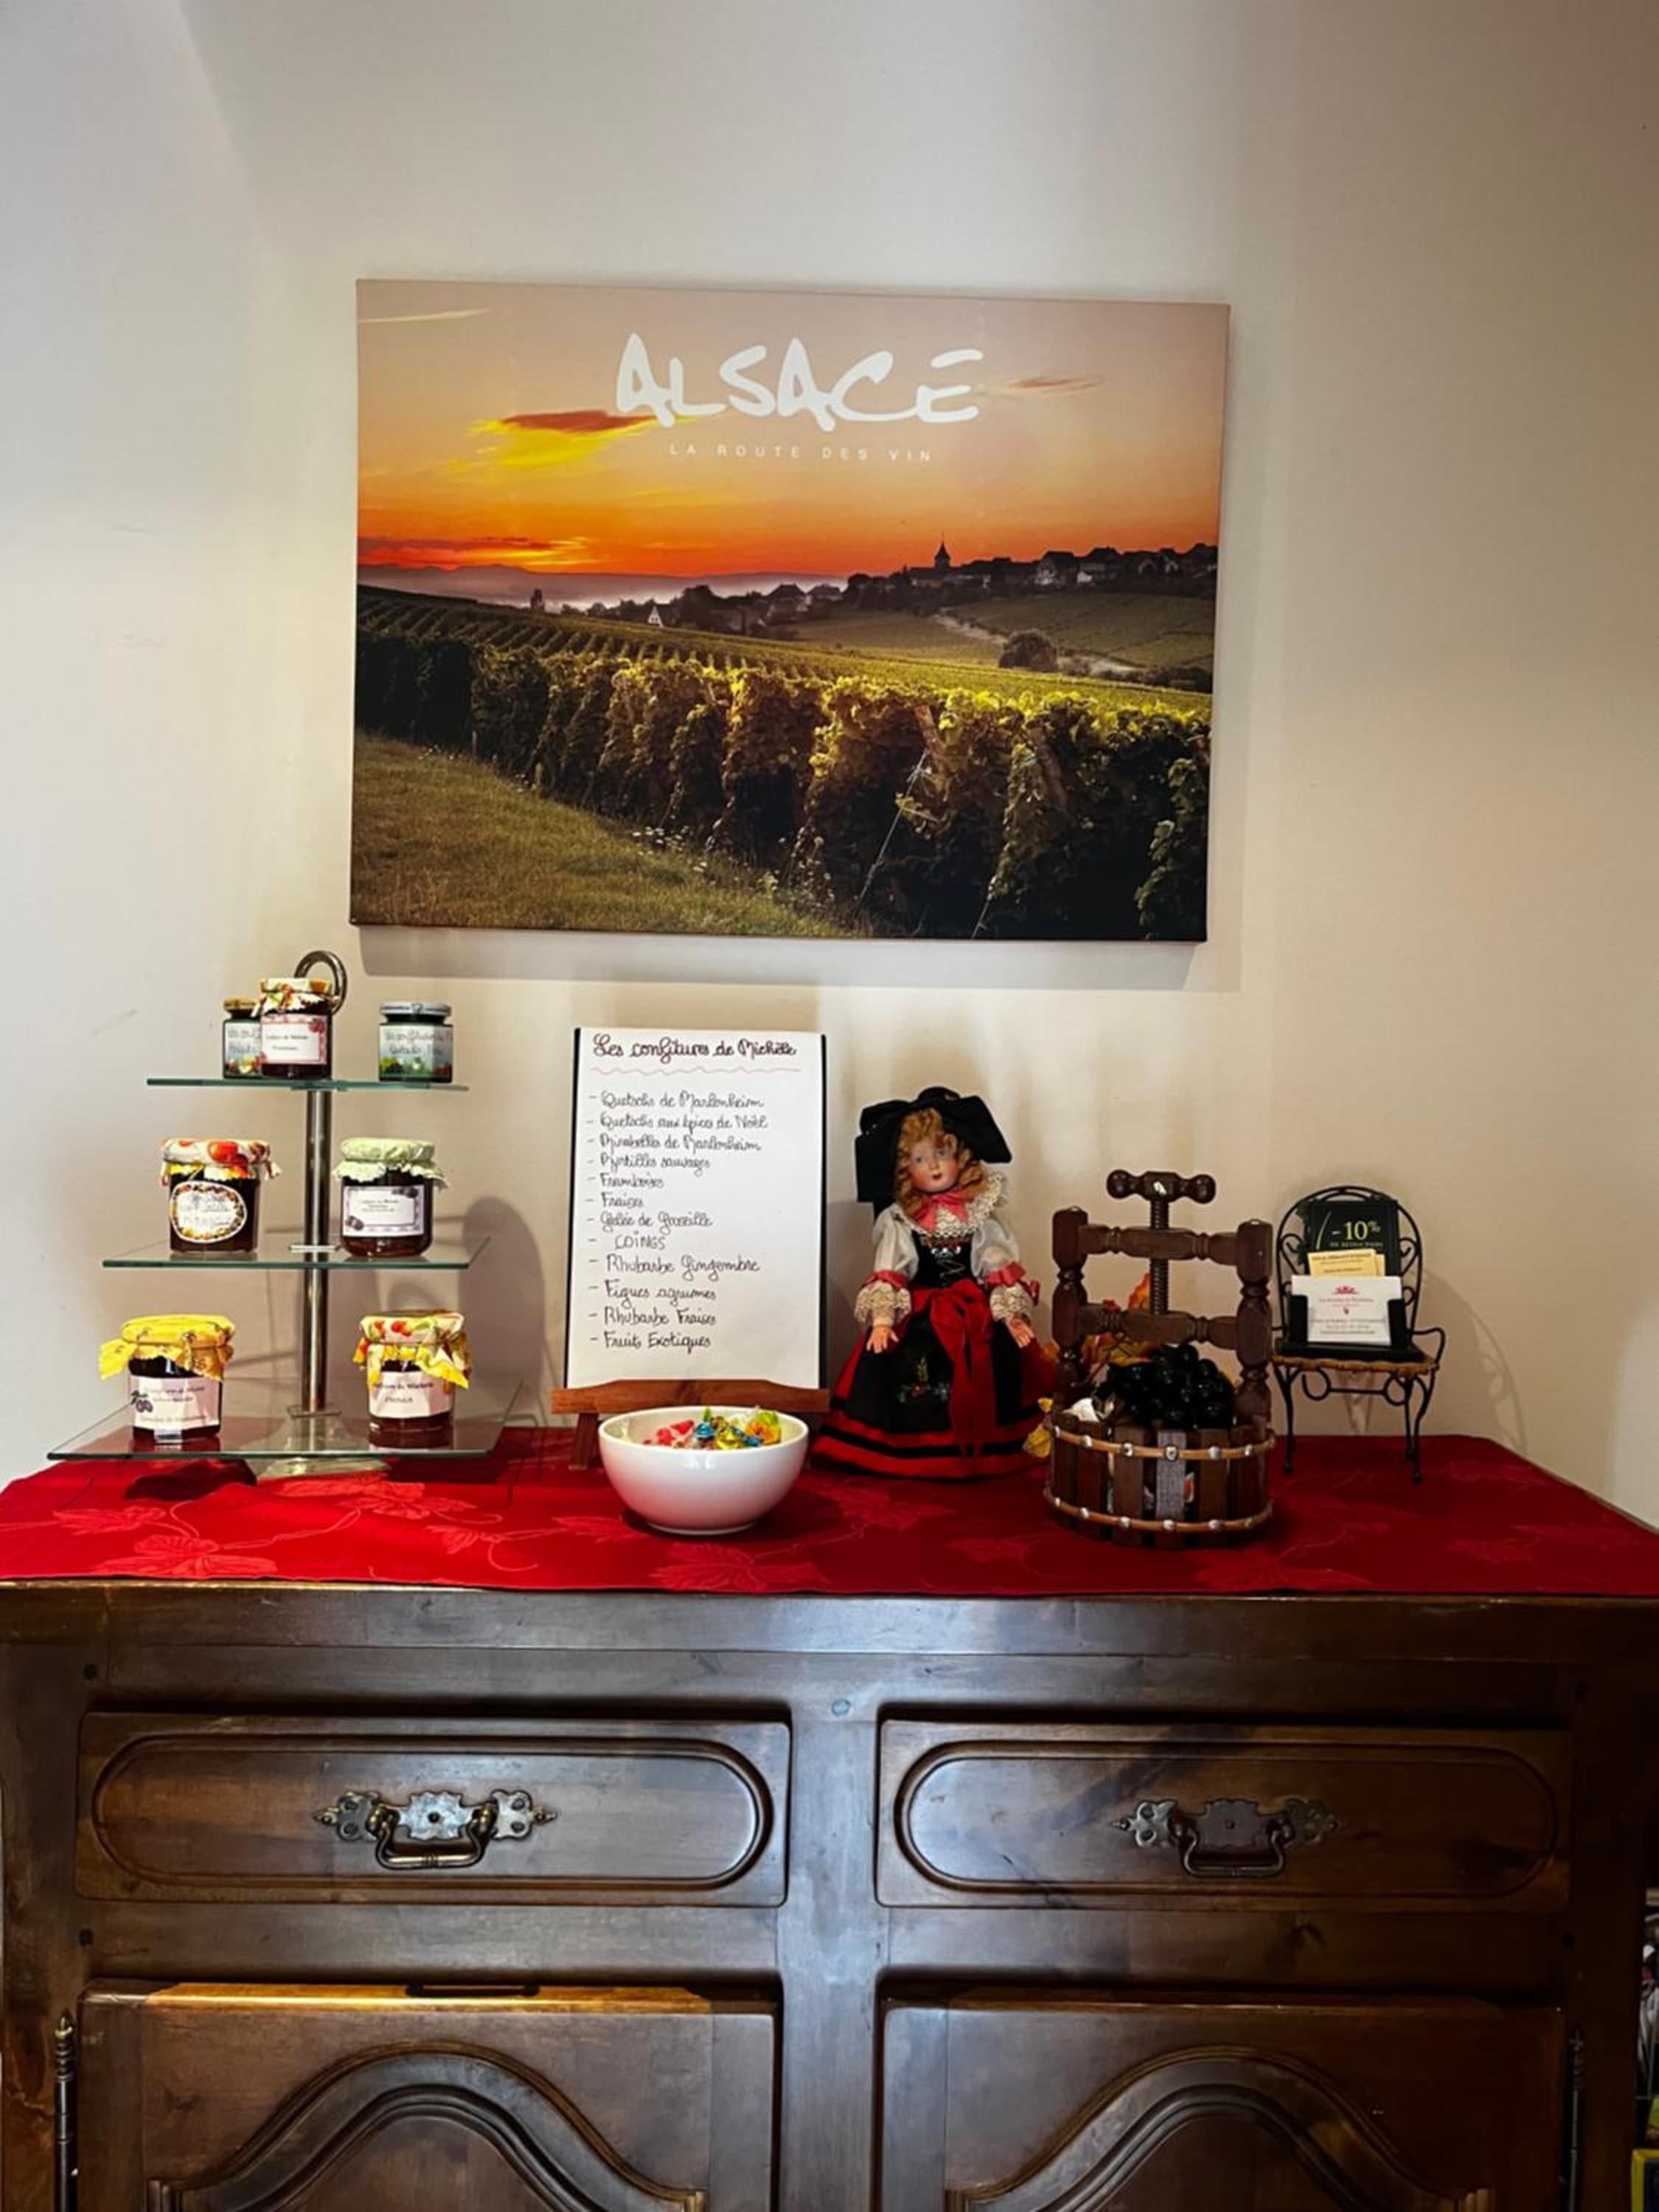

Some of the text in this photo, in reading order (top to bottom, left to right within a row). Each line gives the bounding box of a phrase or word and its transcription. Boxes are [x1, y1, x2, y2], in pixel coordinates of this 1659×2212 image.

[616, 333, 984, 431] ALSACE
[669, 444, 931, 461] LA ROUTE DES VIN
[593, 1032, 625, 1057] Les
[712, 1040, 734, 1057] de
[659, 1092, 676, 1107] de
[716, 1113, 733, 1129] de
[734, 1114, 768, 1129] Noël
[664, 1135, 680, 1149] de
[638, 1212, 654, 1226] de
[606, 1253, 675, 1274] Rhubarbe
[604, 1279, 717, 1309] Figues agrumes
[604, 1306, 669, 1326] Rhubarbe
[604, 1331, 712, 1354] Fruits Exotiques
